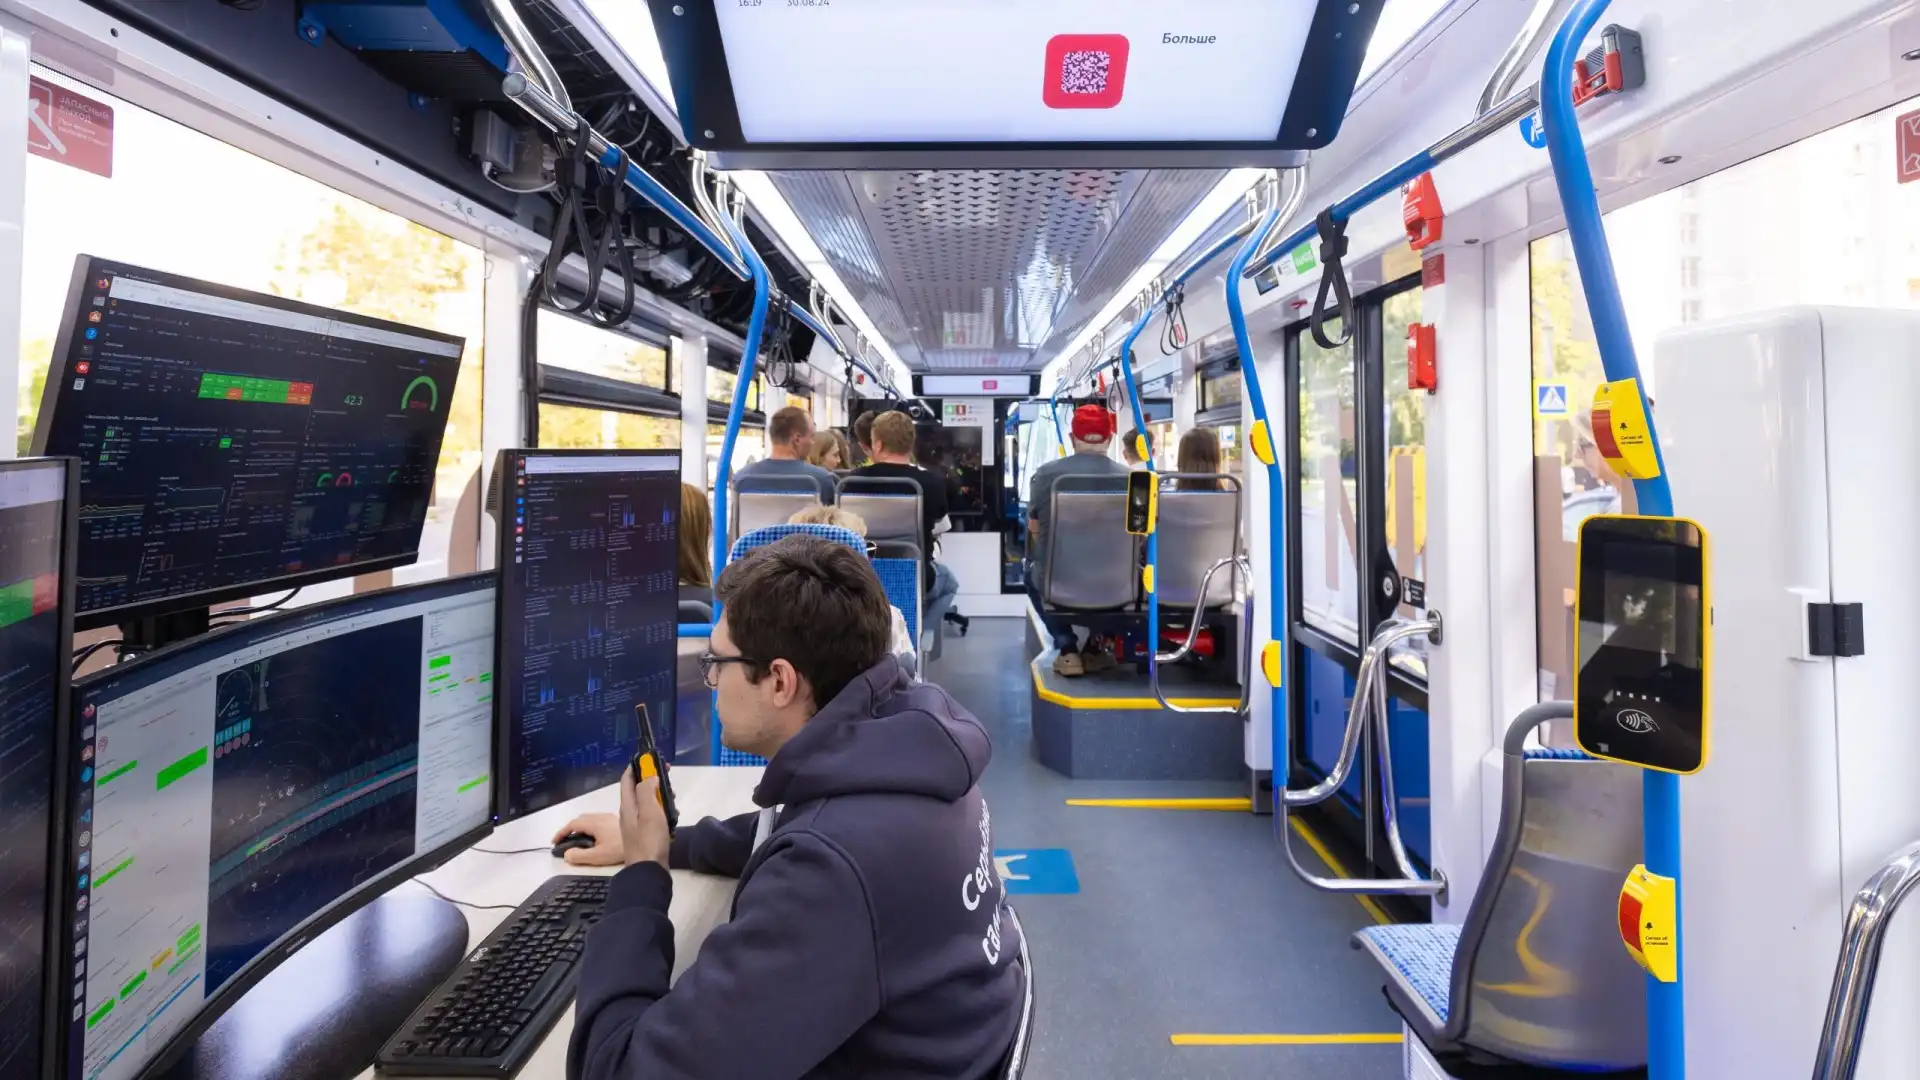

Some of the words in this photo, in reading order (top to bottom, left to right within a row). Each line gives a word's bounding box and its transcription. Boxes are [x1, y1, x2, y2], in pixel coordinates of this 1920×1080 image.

[1162, 32, 1217, 44] Больше
[59, 104, 92, 124] ВЫХОД
[60, 95, 109, 120] ЗАПАСНЫЙ
